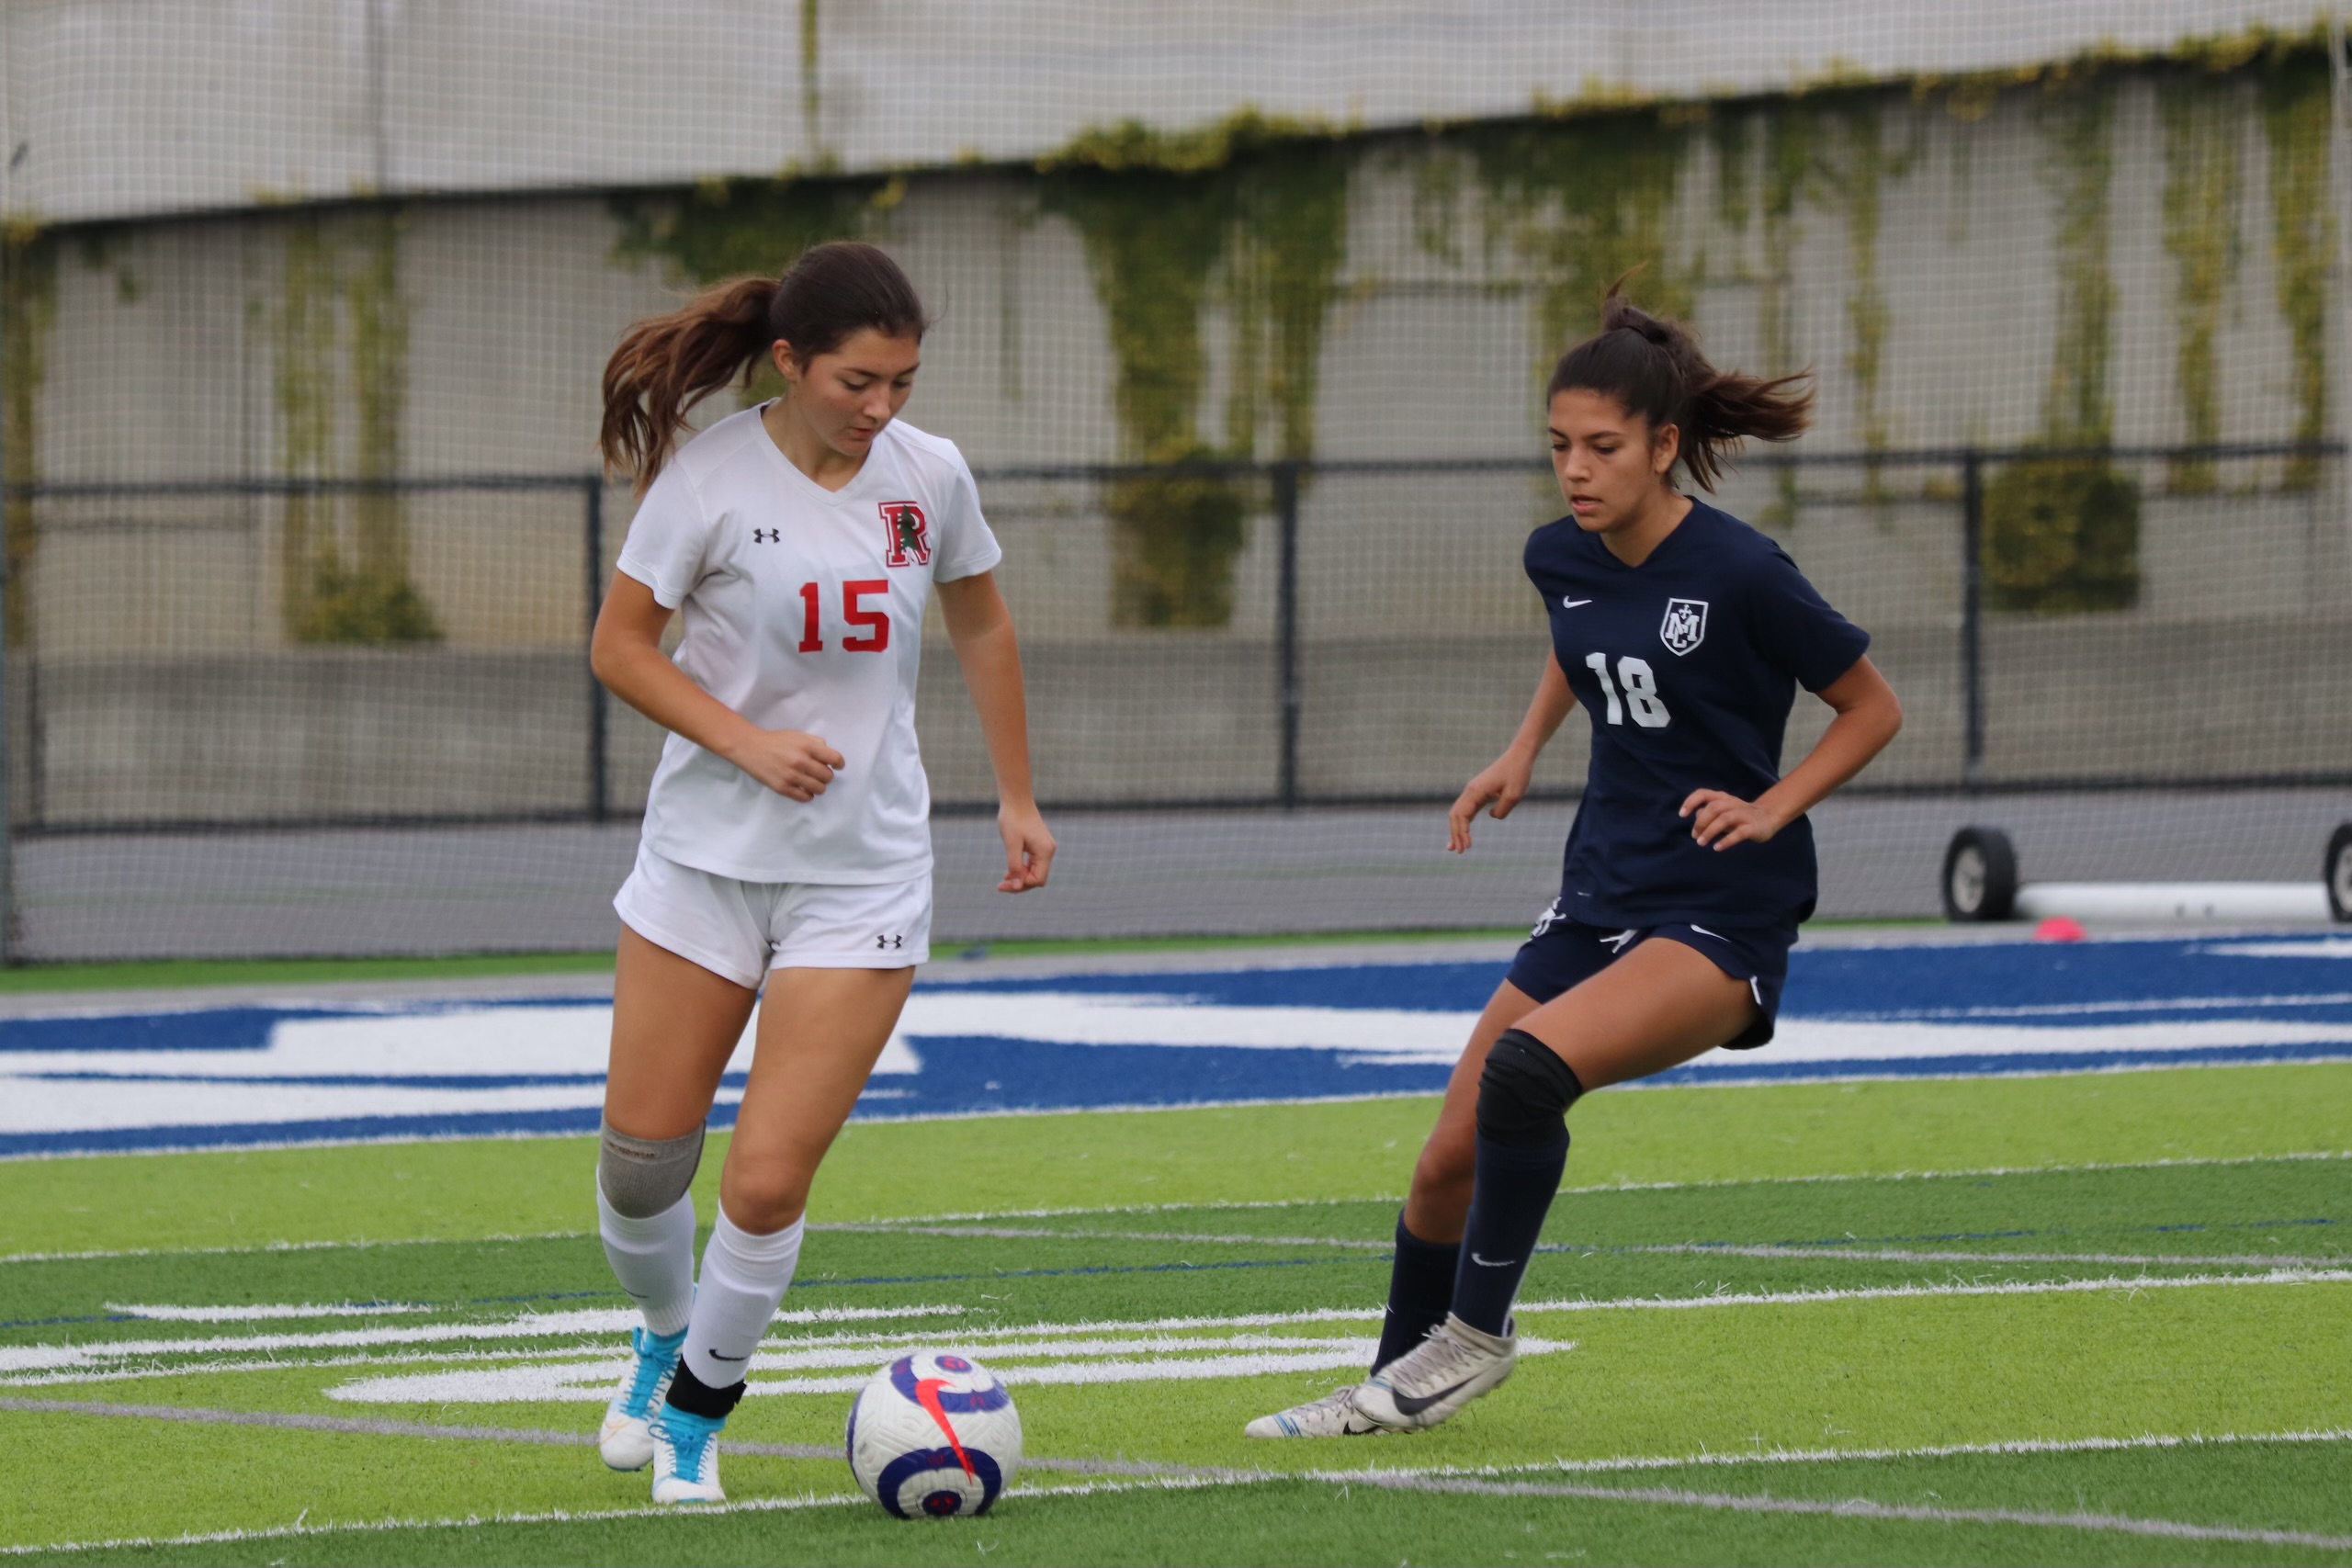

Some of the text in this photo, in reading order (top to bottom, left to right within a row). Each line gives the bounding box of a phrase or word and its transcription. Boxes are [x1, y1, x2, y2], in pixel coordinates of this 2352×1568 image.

[877, 501, 932, 568] R
[798, 580, 890, 653] 15
[1585, 651, 1672, 728] 18
